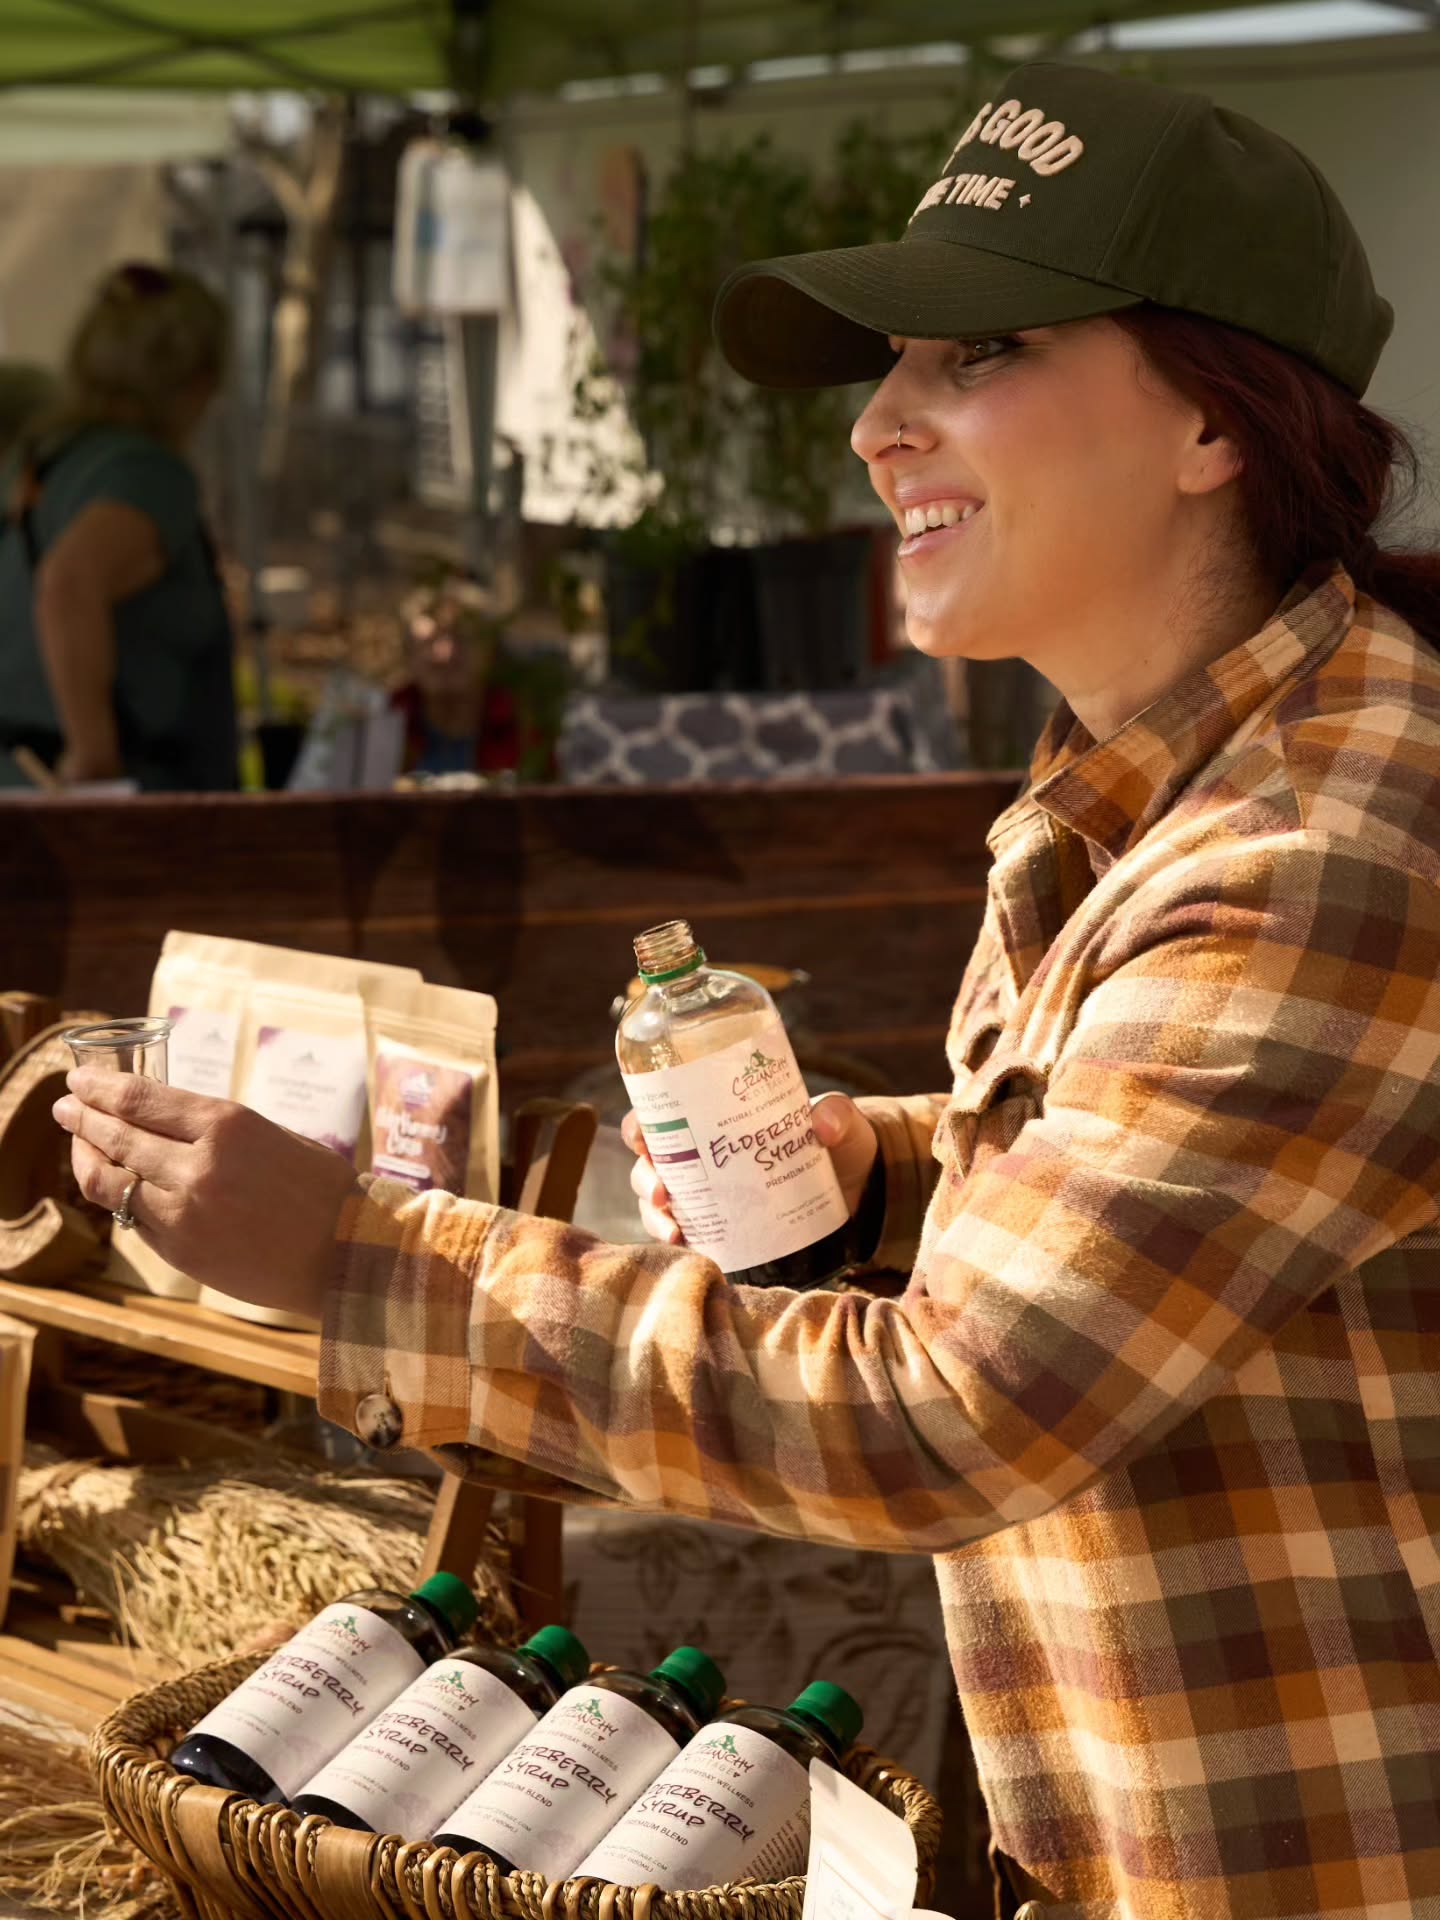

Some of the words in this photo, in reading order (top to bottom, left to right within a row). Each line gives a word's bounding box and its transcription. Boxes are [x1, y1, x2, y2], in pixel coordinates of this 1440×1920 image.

[979, 99, 1085, 177] GOOD
[944, 173, 1017, 211] TIME
[717, 1110, 753, 1128] NATURAL
[709, 1104, 813, 1168] ELDERBER
[754, 1127, 816, 1171] SYRUP
[765, 1166, 805, 1189] PREMIUM
[259, 1665, 321, 1699] SYRUP
[441, 1709, 478, 1741] WELLNESS
[364, 1727, 428, 1755] SYRUP
[581, 1741, 619, 1771] WELLNESS
[384, 1752, 410, 1771] BLEND
[504, 1756, 570, 1790] SYRUP
[525, 1788, 553, 1808] BLEND
[716, 1777, 754, 1808] WELLNESS
[636, 1795, 706, 1828] SYRUP
[661, 1827, 689, 1847] BLEND
